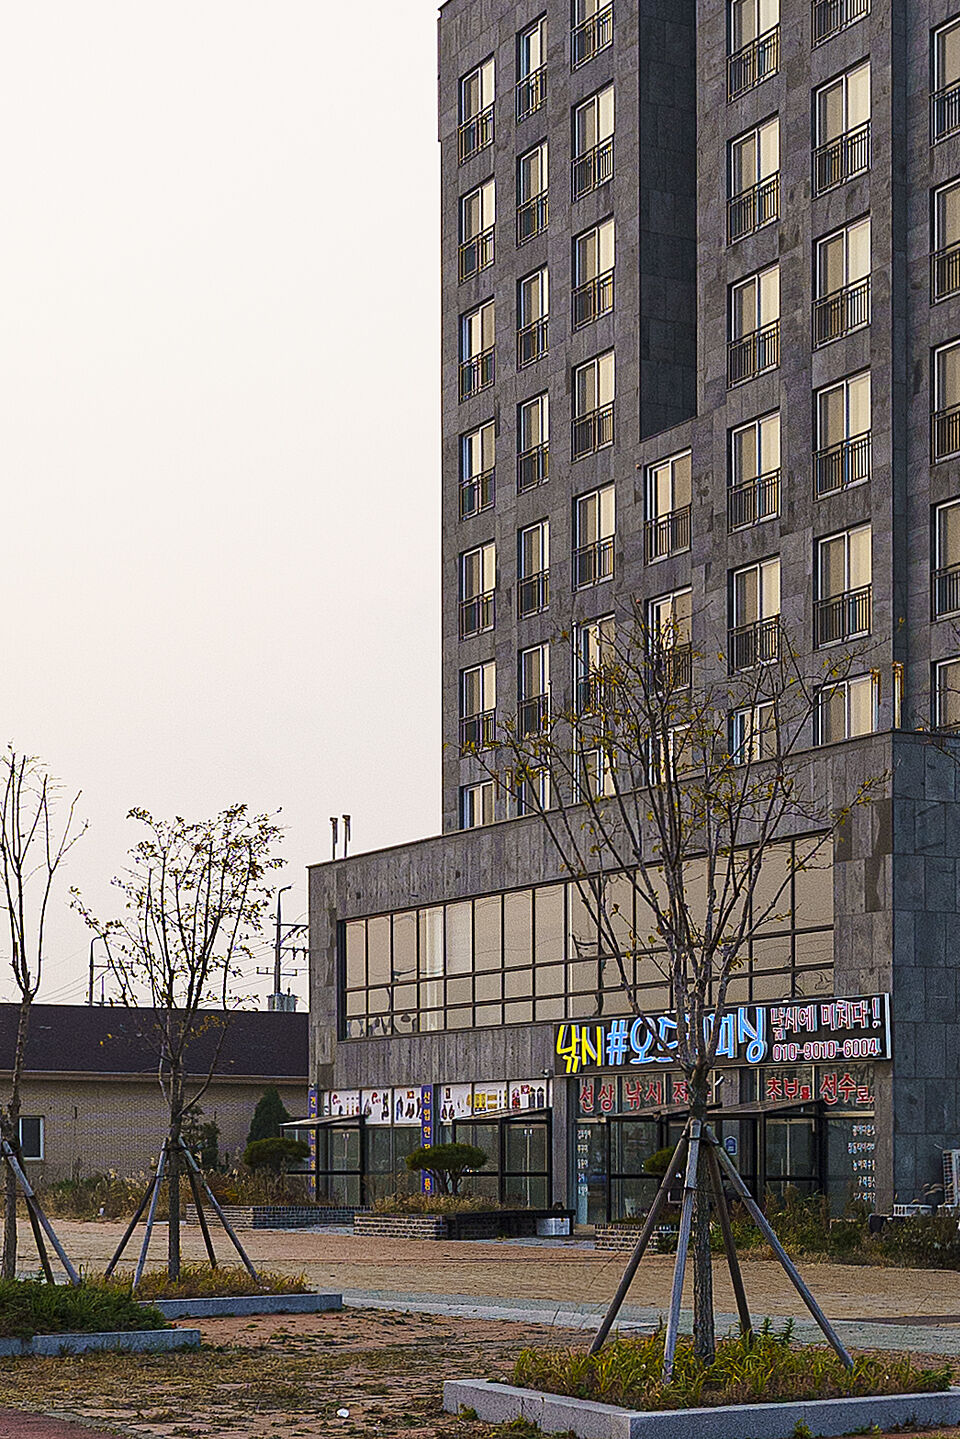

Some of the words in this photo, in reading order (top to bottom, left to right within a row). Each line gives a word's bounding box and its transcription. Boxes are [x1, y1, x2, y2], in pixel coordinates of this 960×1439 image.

[770, 1004, 817, 1041] 낚시에
[821, 997, 881, 1031] 미치다!
[772, 1037, 881, 1062] 010-9010-6004
[579, 1083, 614, 1112] 선상
[625, 1078, 662, 1110] 낚시
